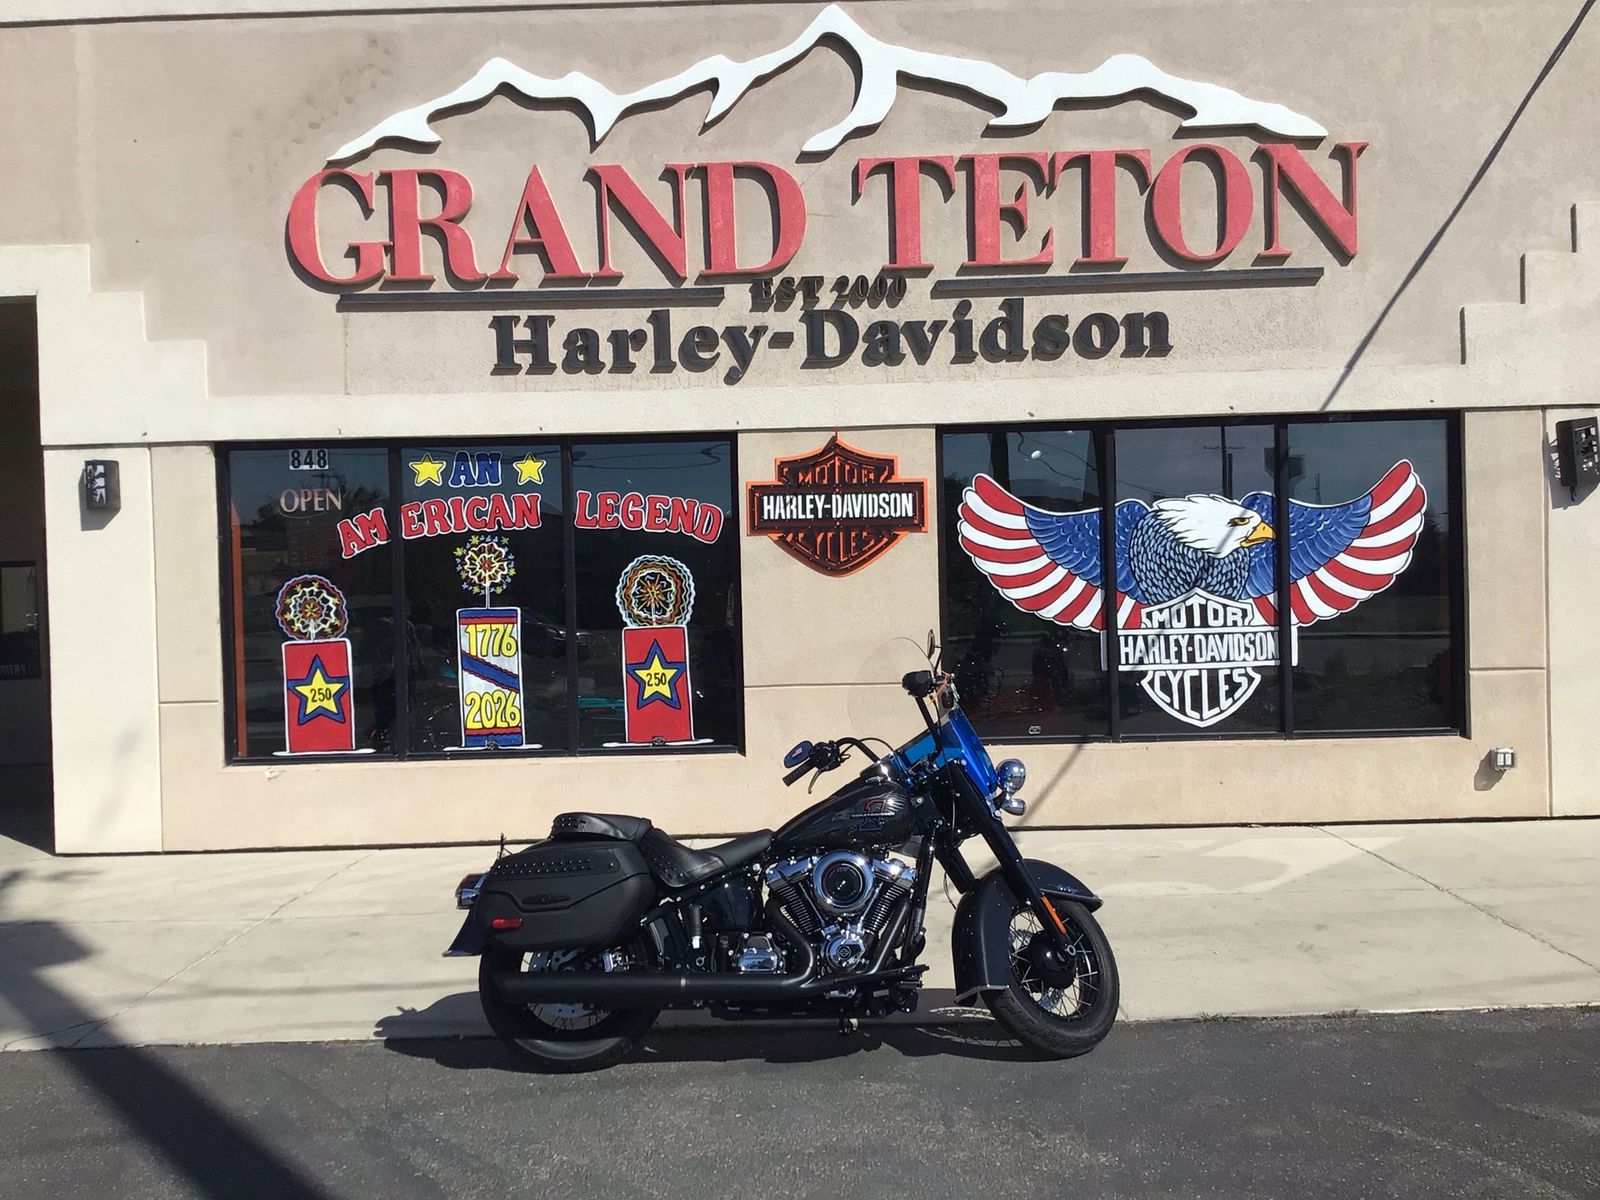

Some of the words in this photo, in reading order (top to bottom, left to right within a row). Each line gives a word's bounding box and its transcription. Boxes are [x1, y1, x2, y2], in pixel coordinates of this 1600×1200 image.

[285, 161, 806, 293] GRAND
[852, 141, 1370, 271] TETON
[749, 276, 824, 312] EST
[830, 275, 907, 310] 2000
[488, 298, 1174, 385] Harley-Davidson
[290, 449, 328, 469] 848
[448, 450, 502, 488] AN
[798, 456, 875, 485] MOTOR
[280, 487, 342, 513] OPEN
[573, 490, 724, 544] LEGEND
[763, 493, 914, 520] HARLEY-DAVIDSON
[1151, 591, 1244, 628] MOTOR
[464, 623, 518, 657] 1776
[309, 687, 332, 703] 250
[645, 672, 667, 687] 250
[1153, 667, 1249, 720] CYCLES
[465, 689, 521, 730] 2026
